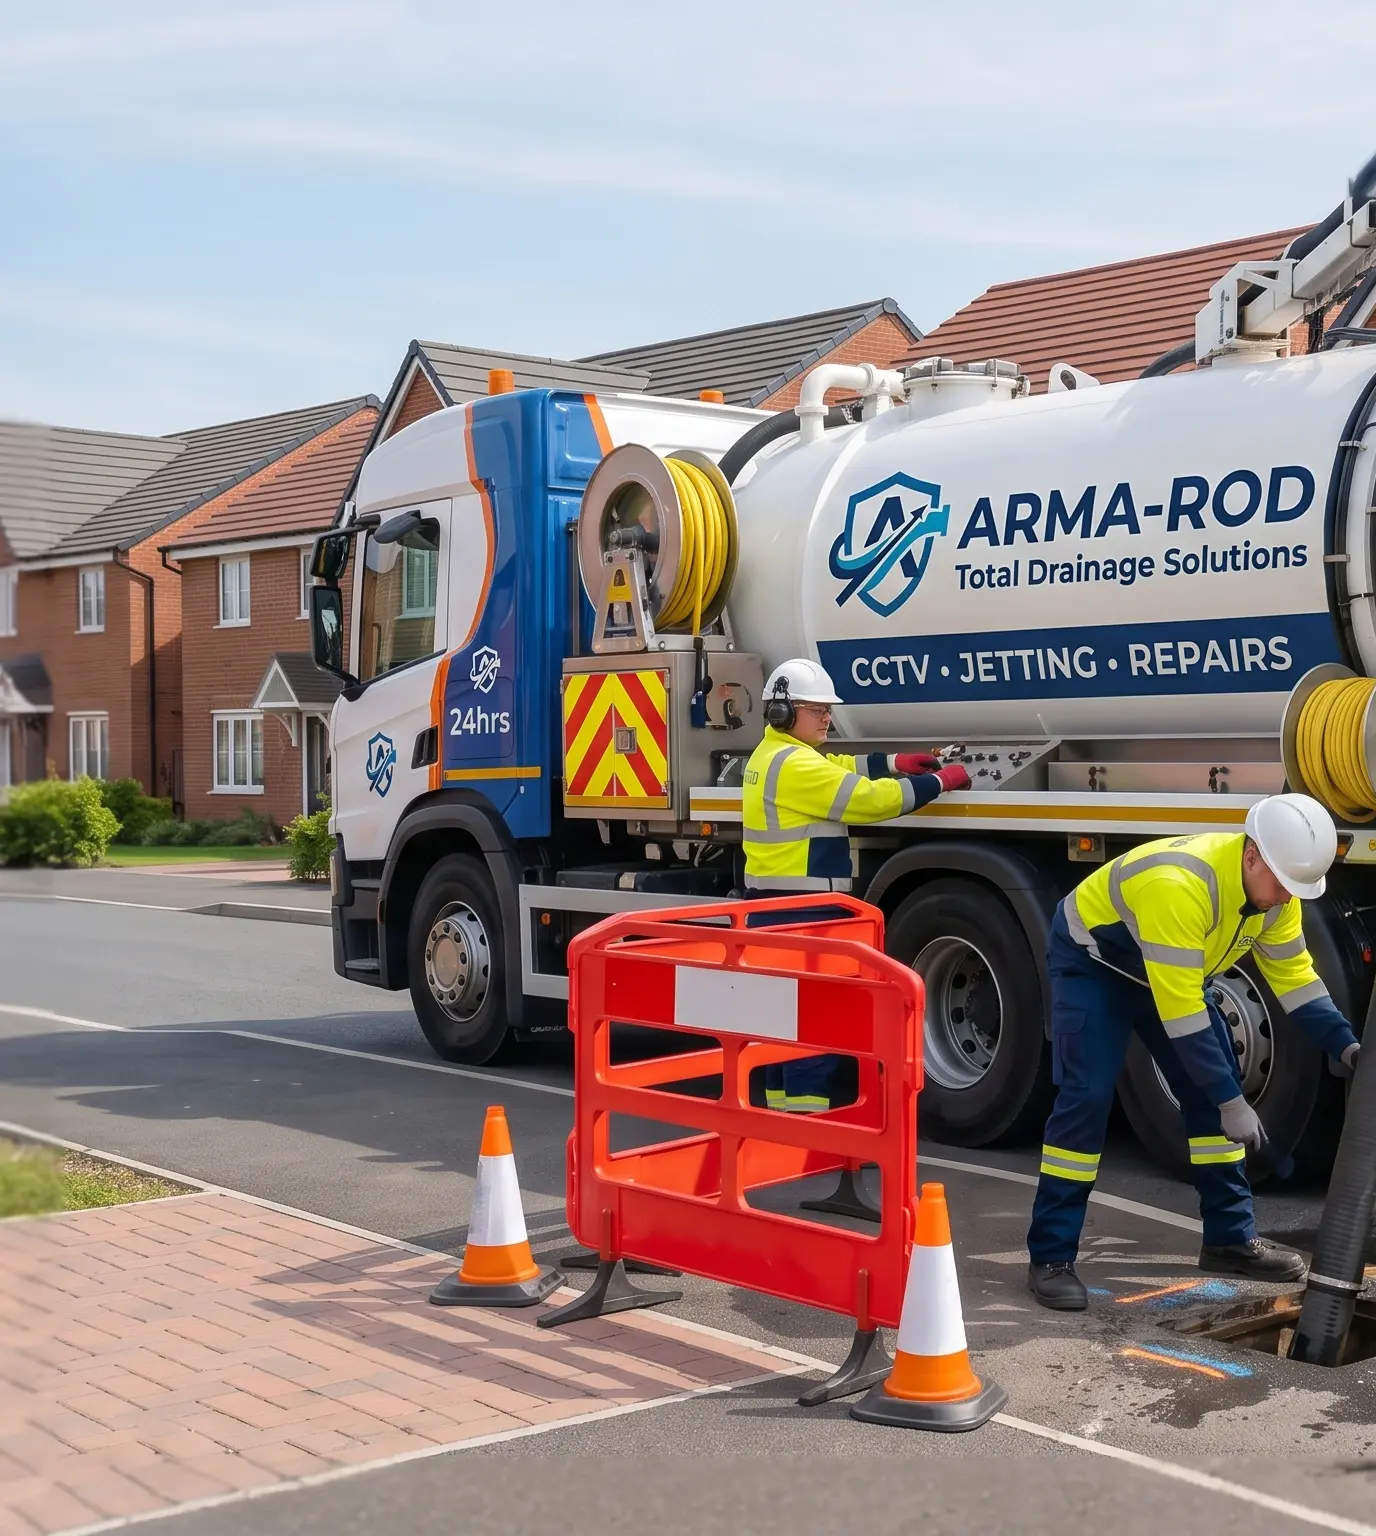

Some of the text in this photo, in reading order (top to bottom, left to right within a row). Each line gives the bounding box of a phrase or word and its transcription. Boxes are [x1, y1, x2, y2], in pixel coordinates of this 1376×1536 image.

[957, 464, 1316, 549] ARMA-ROD
[955, 541, 1308, 590] Total Drainage Solutions
[851, 636, 1293, 686] CCTV JETTING REPAIRS
[450, 706, 511, 736] 24hrs
